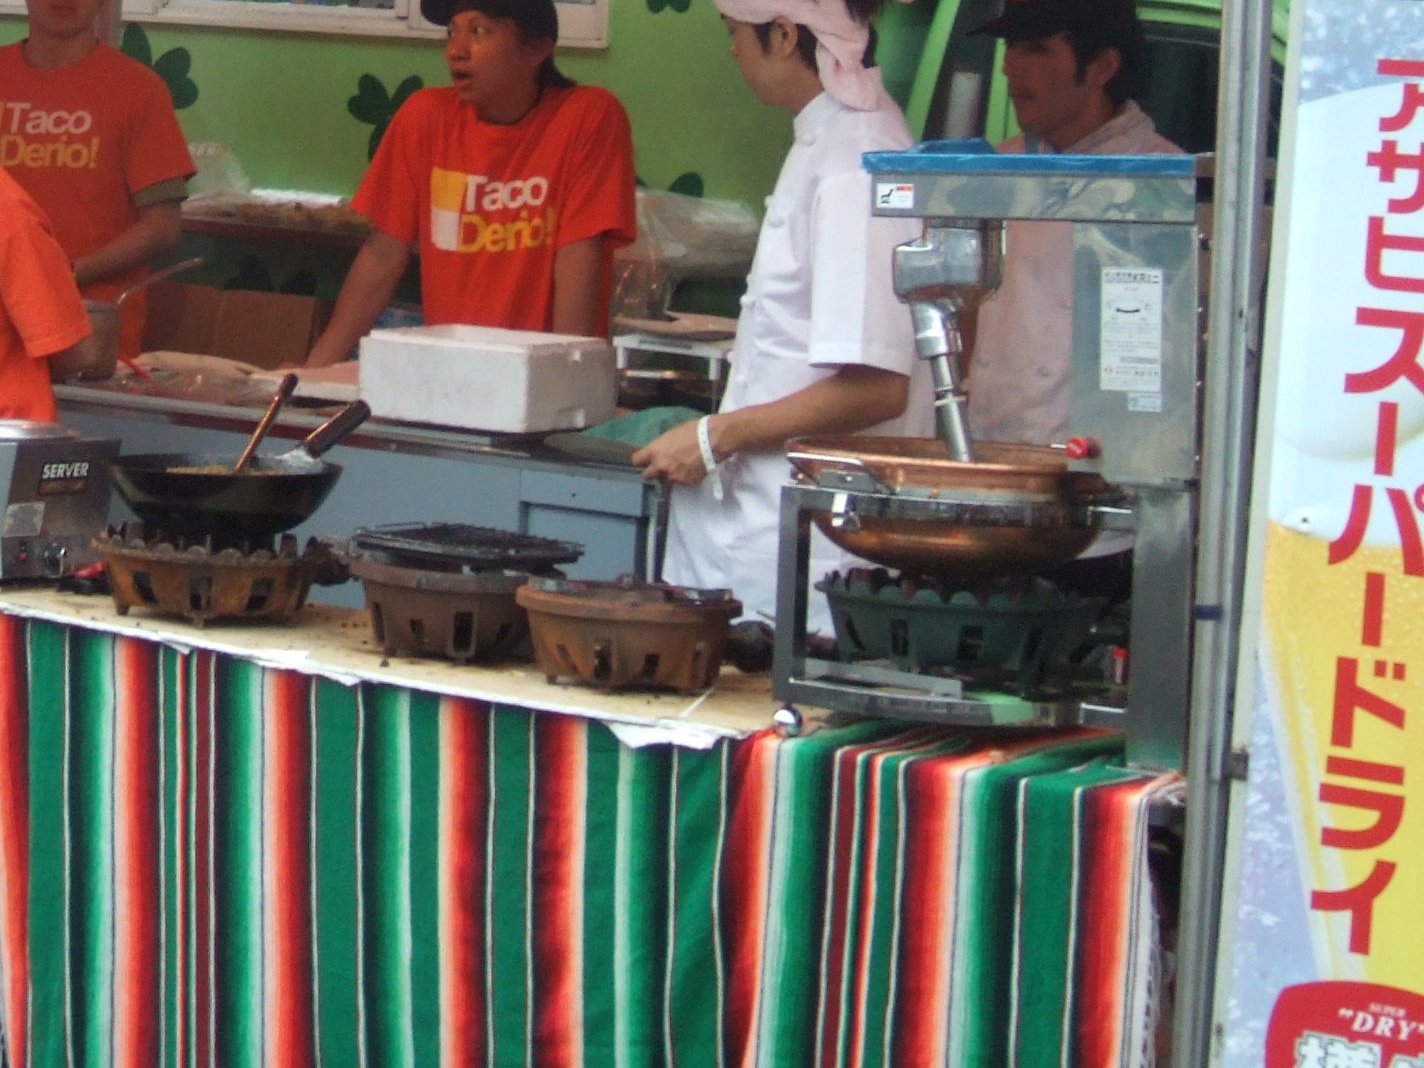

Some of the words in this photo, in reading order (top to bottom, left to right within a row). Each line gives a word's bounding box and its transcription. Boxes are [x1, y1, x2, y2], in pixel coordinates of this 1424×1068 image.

[5, 101, 93, 135] Taco
[464, 173, 549, 213] Taco
[41, 461, 90, 480] SERVER
